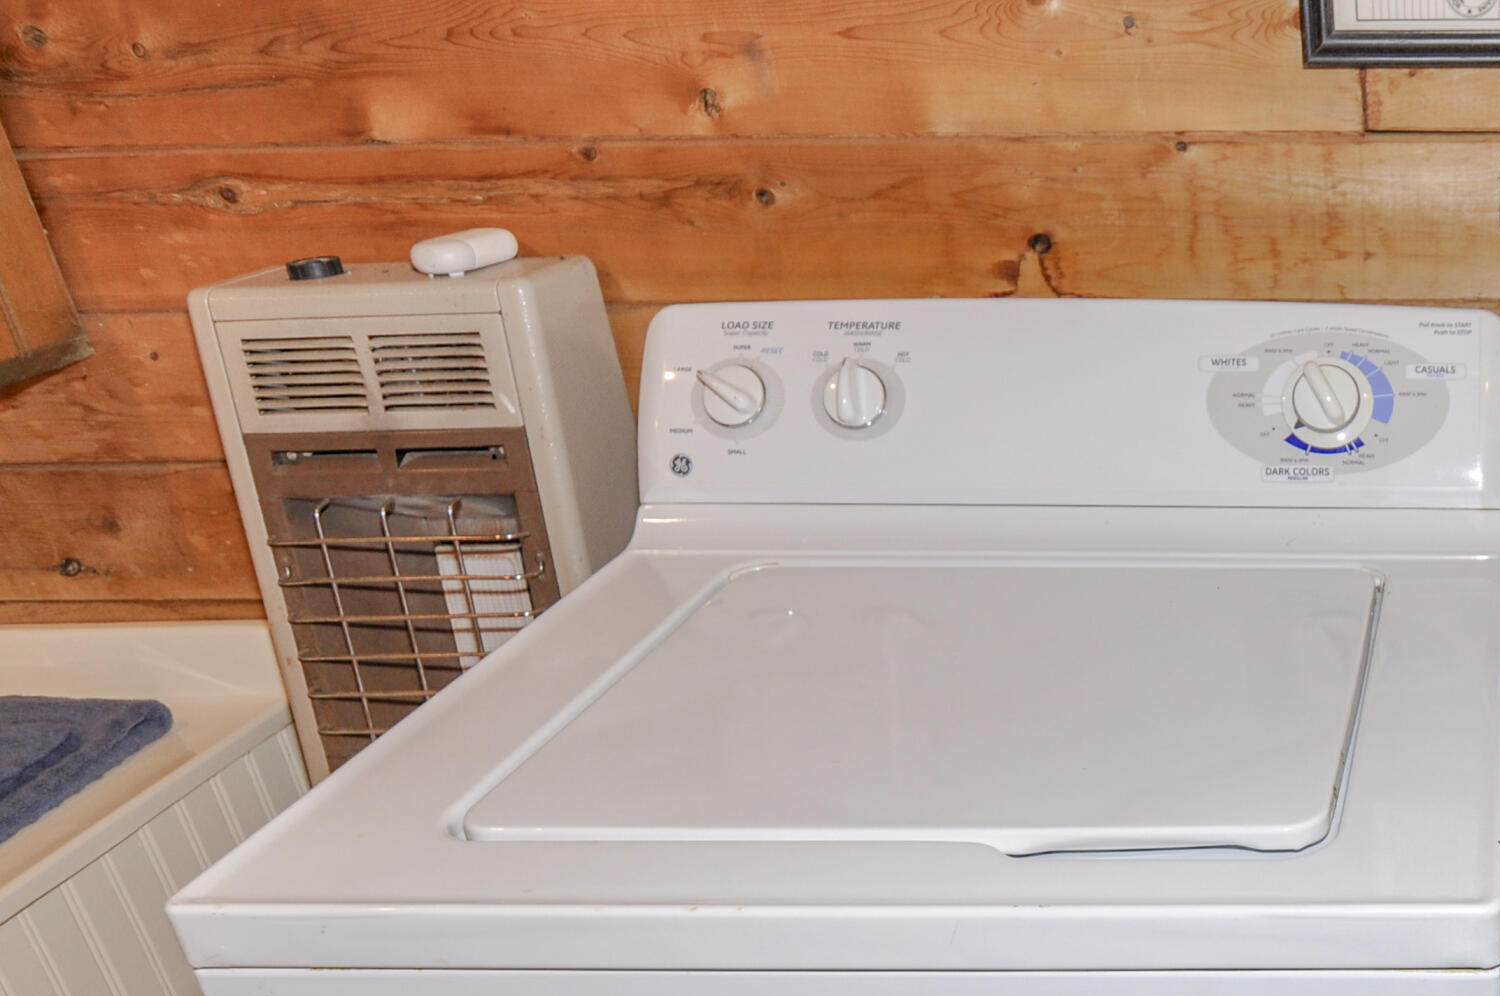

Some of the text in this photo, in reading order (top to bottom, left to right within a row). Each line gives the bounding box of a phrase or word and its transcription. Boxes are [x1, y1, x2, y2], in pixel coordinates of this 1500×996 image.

[721, 321, 774, 330] LOAD SIZE
[828, 321, 902, 330] TEMPERATURE
[1210, 358, 1247, 367] WHITES
[1414, 365, 1456, 375] CASUALS
[1265, 467, 1330, 476] DARK COLORS
